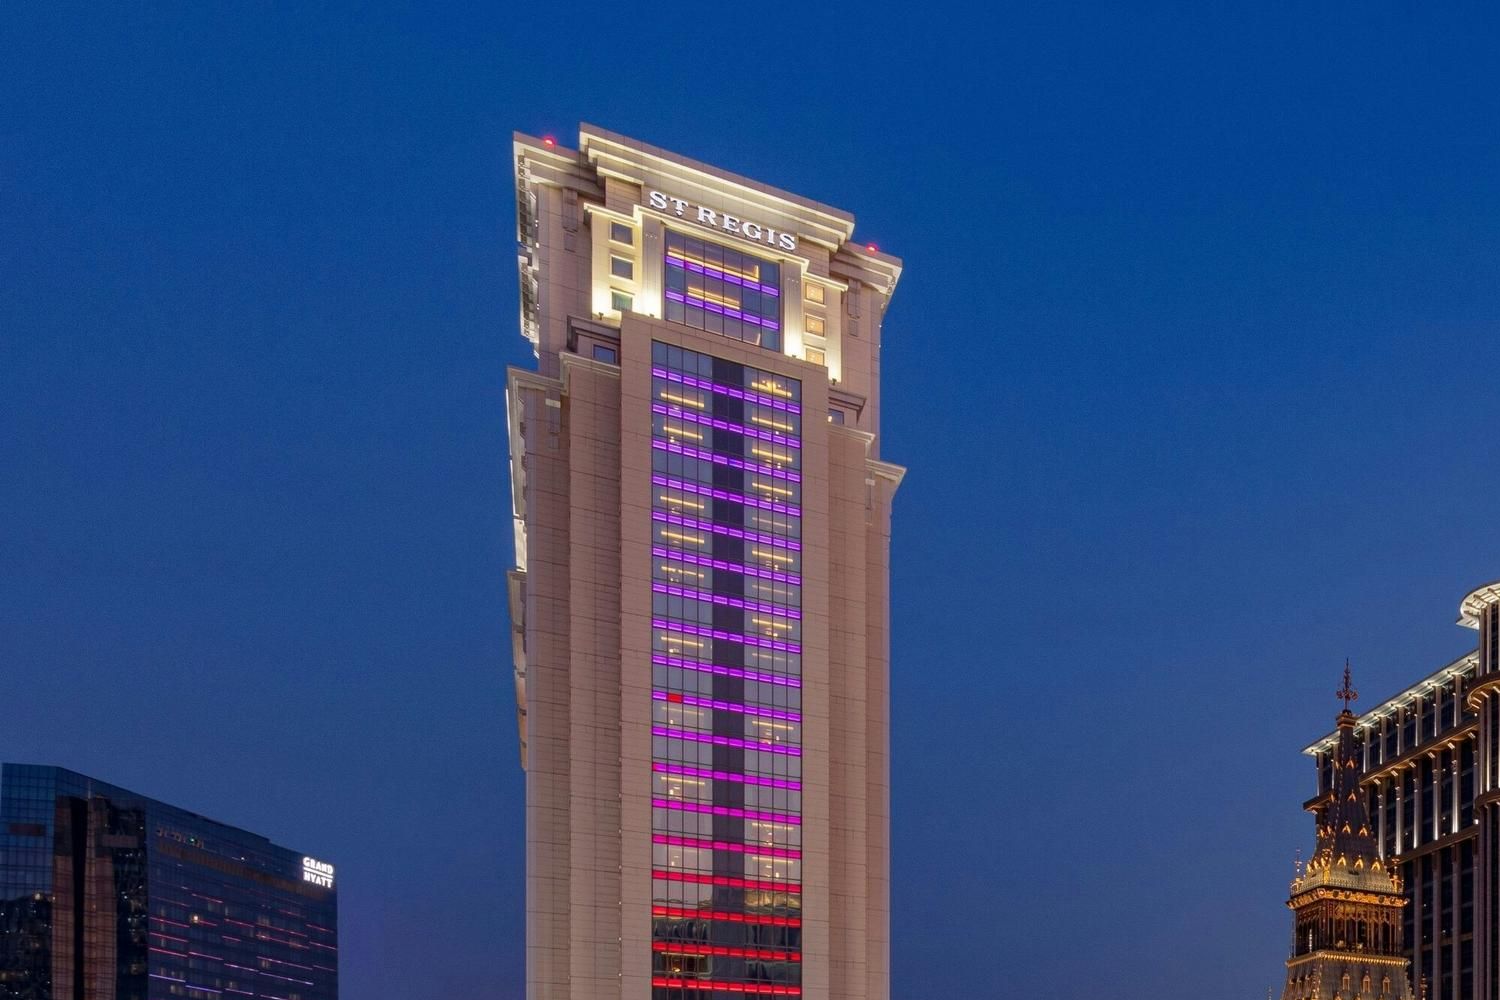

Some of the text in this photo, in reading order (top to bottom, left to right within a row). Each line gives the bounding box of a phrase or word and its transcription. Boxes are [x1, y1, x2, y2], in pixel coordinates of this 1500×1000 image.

[697, 206, 796, 250] REGIS
[303, 857, 334, 874] GRAND
[303, 871, 333, 888] HYATT
